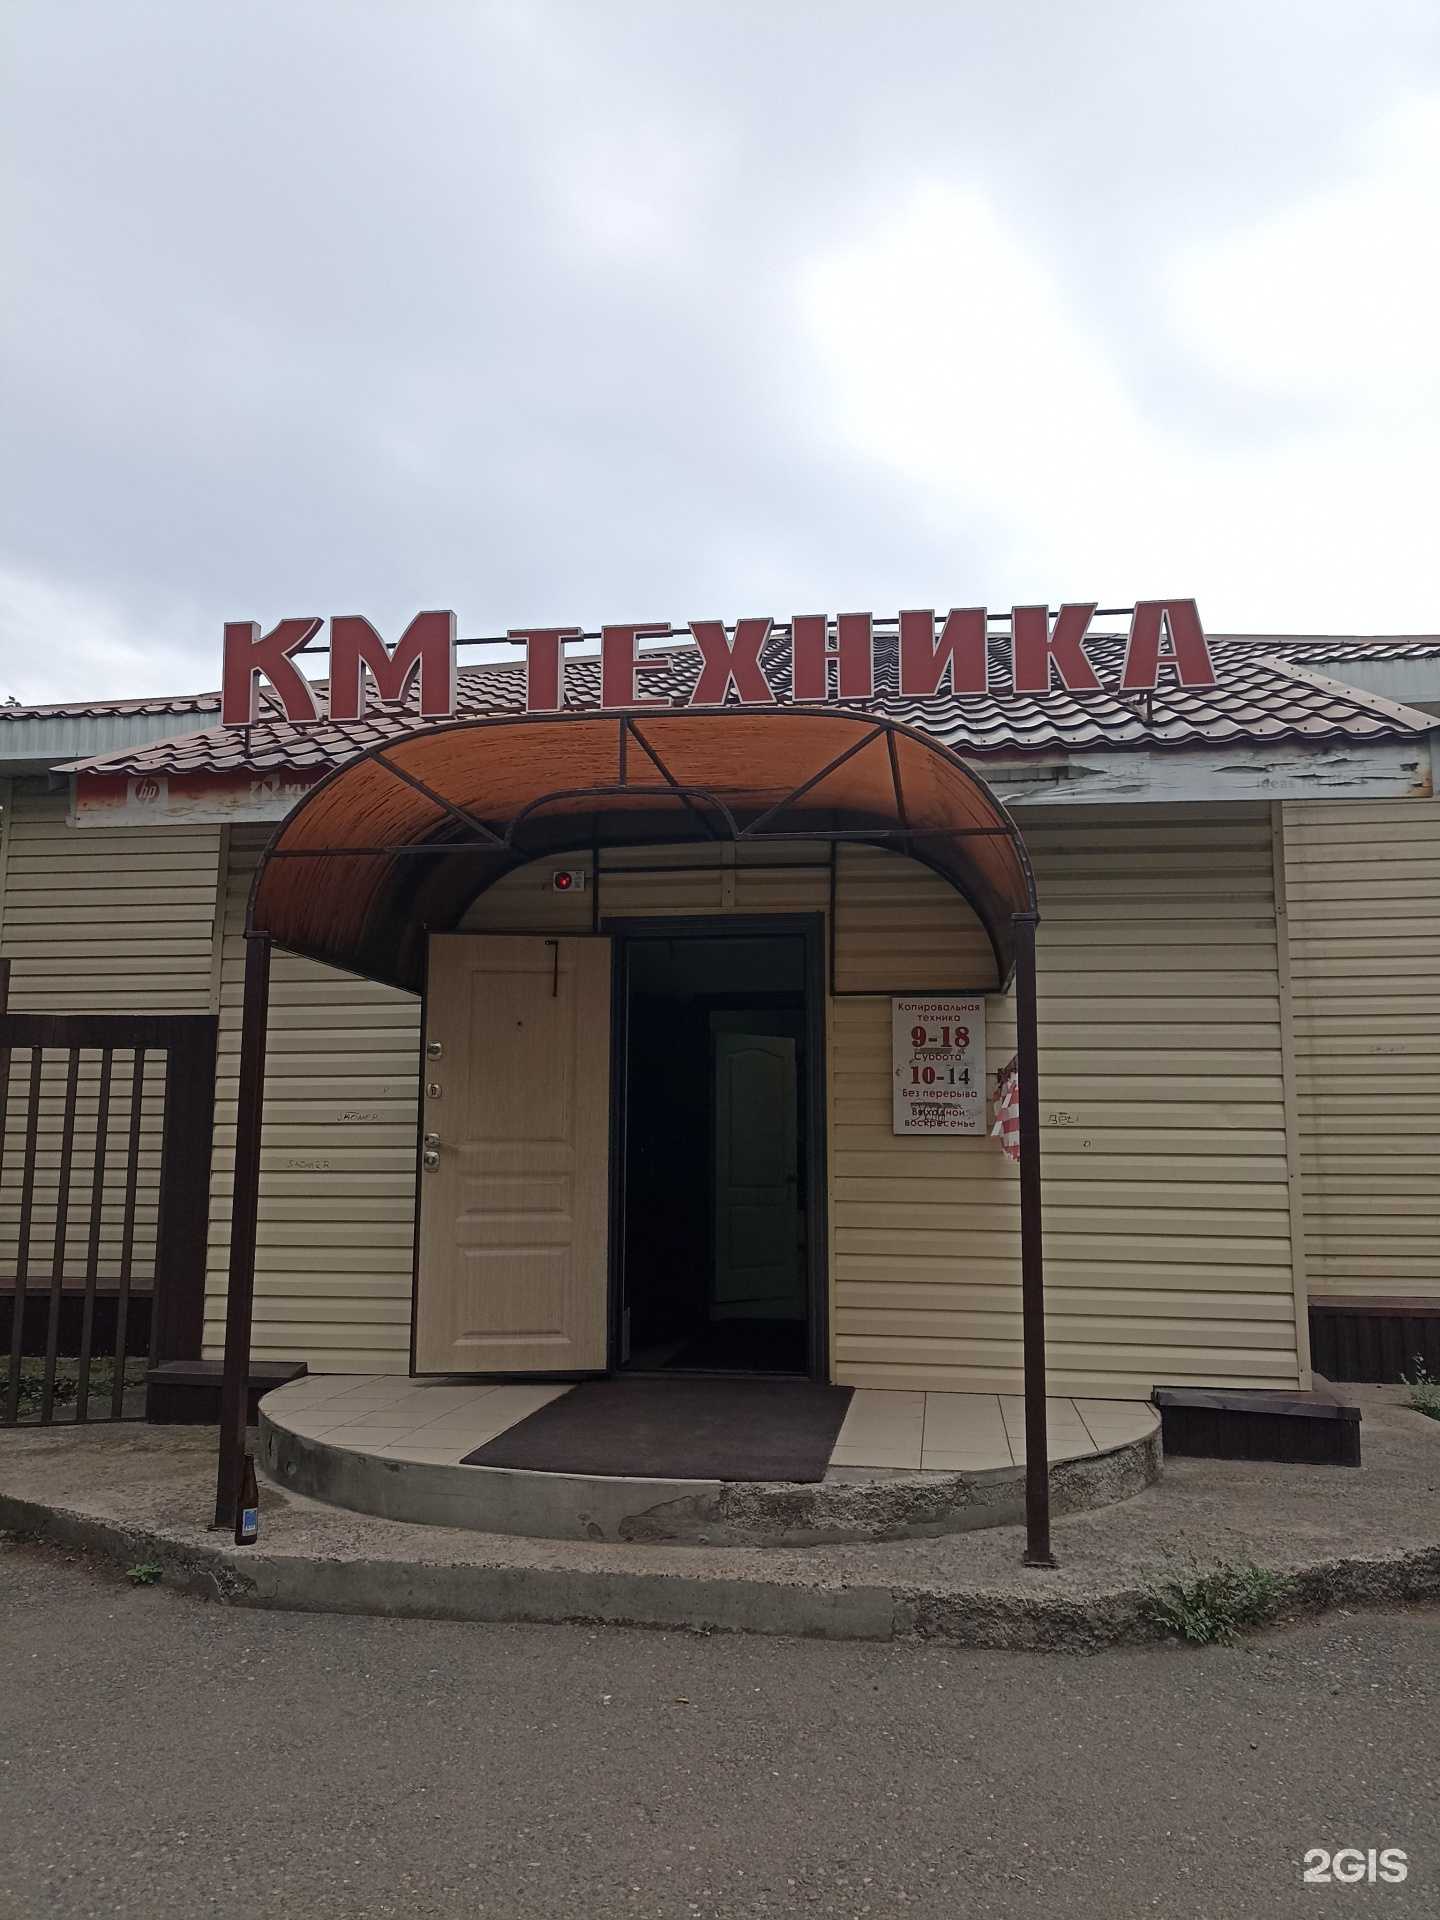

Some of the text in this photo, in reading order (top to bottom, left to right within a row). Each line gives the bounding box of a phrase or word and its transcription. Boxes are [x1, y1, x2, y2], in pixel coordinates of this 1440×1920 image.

[221, 599, 1217, 728] КМ ТЕХНИКА
[138, 779, 159, 803] hp
[897, 1002, 980, 1012] Копировальная
[917, 1014, 960, 1022] техника
[911, 1025, 970, 1048] 9-18
[914, 1052, 961, 1062] Суббота
[910, 1066, 970, 1085] 10-14
[902, 1088, 977, 1100] Без перерыва
[904, 1119, 976, 1129] воскресенье
